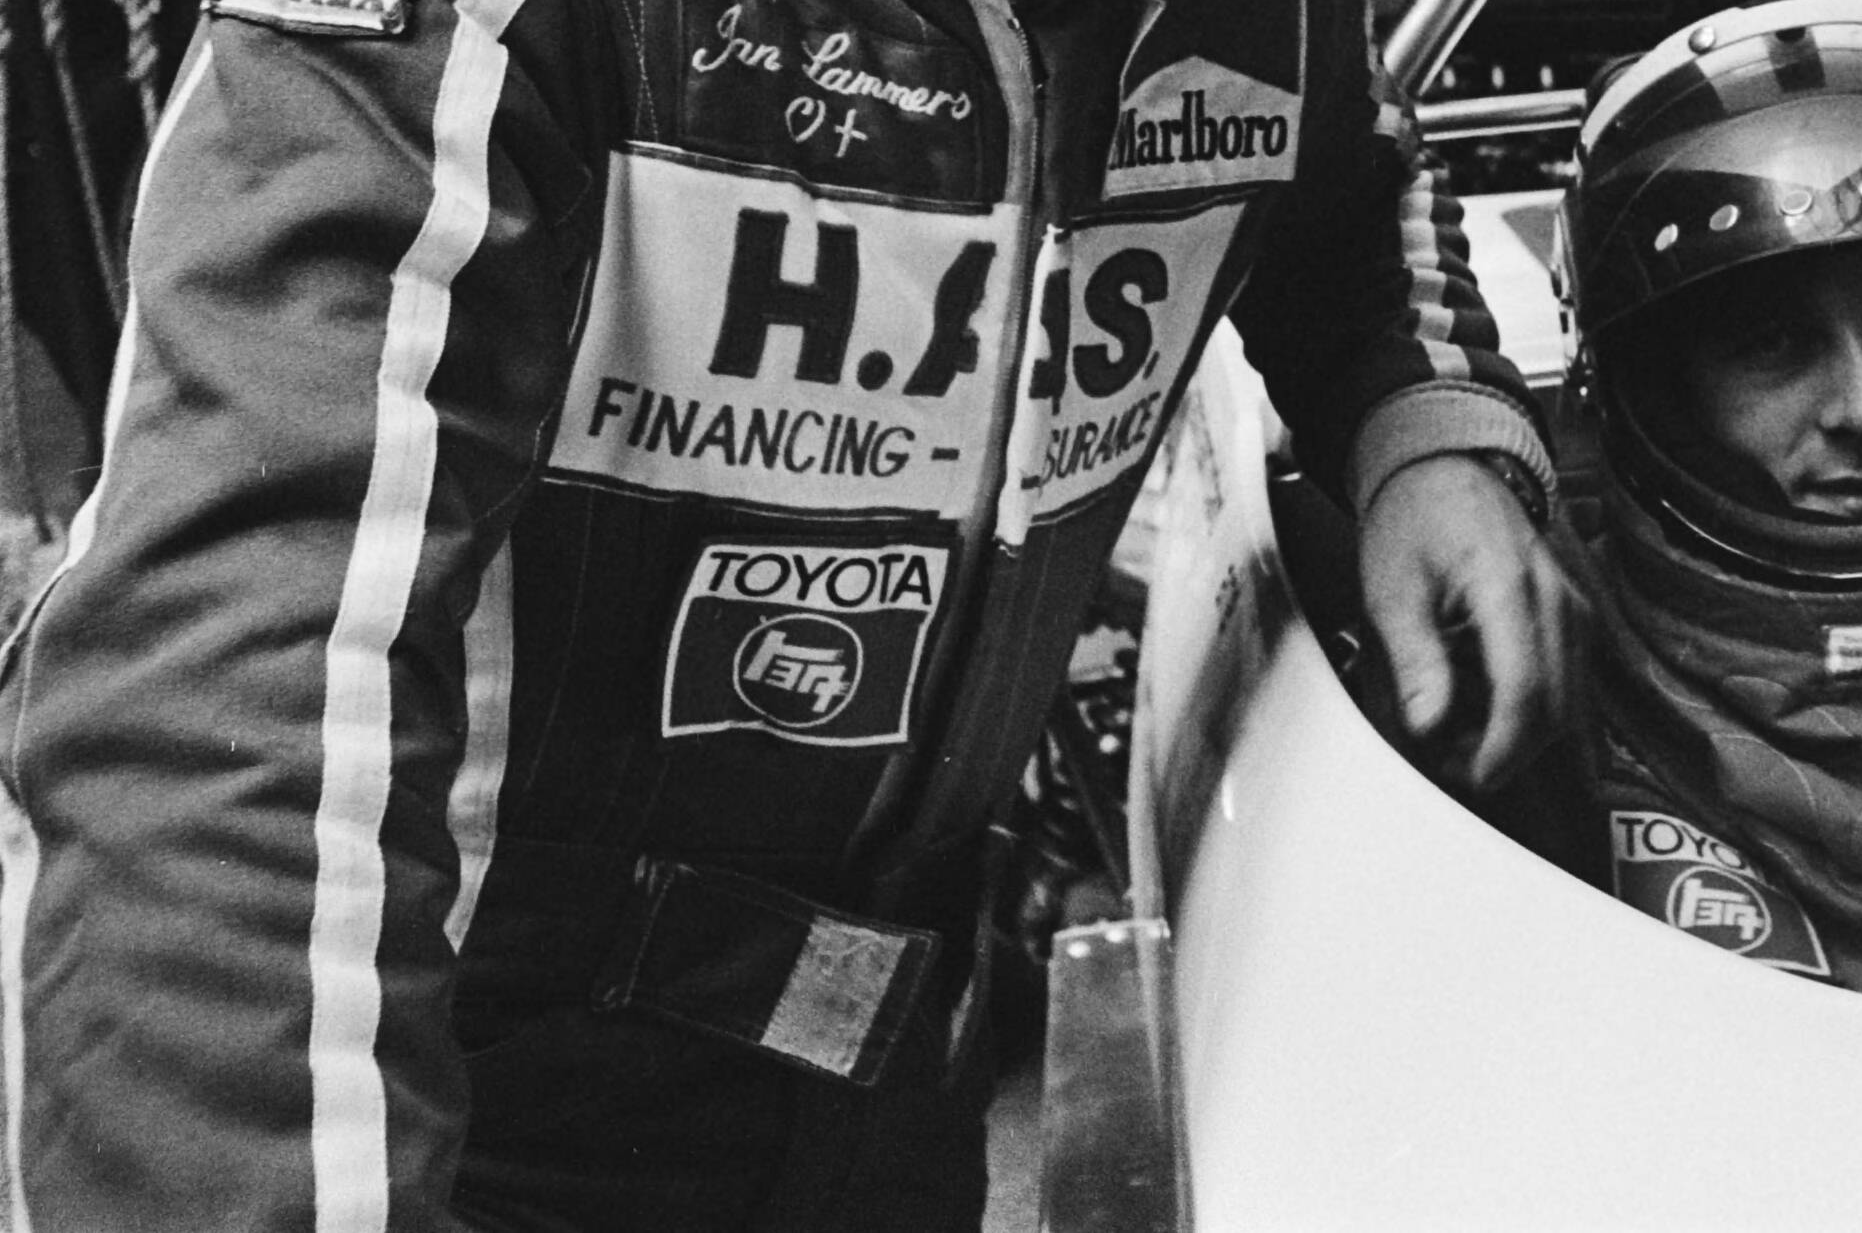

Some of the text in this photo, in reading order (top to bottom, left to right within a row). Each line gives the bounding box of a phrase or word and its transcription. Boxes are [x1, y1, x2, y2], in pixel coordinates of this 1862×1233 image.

[802, 32, 972, 120] Lammers
[1109, 89, 1288, 170] Marlboro
[588, 377, 915, 477] FINANCING
[708, 551, 933, 608] TOYOTA
[1616, 817, 1746, 870] TOYO
